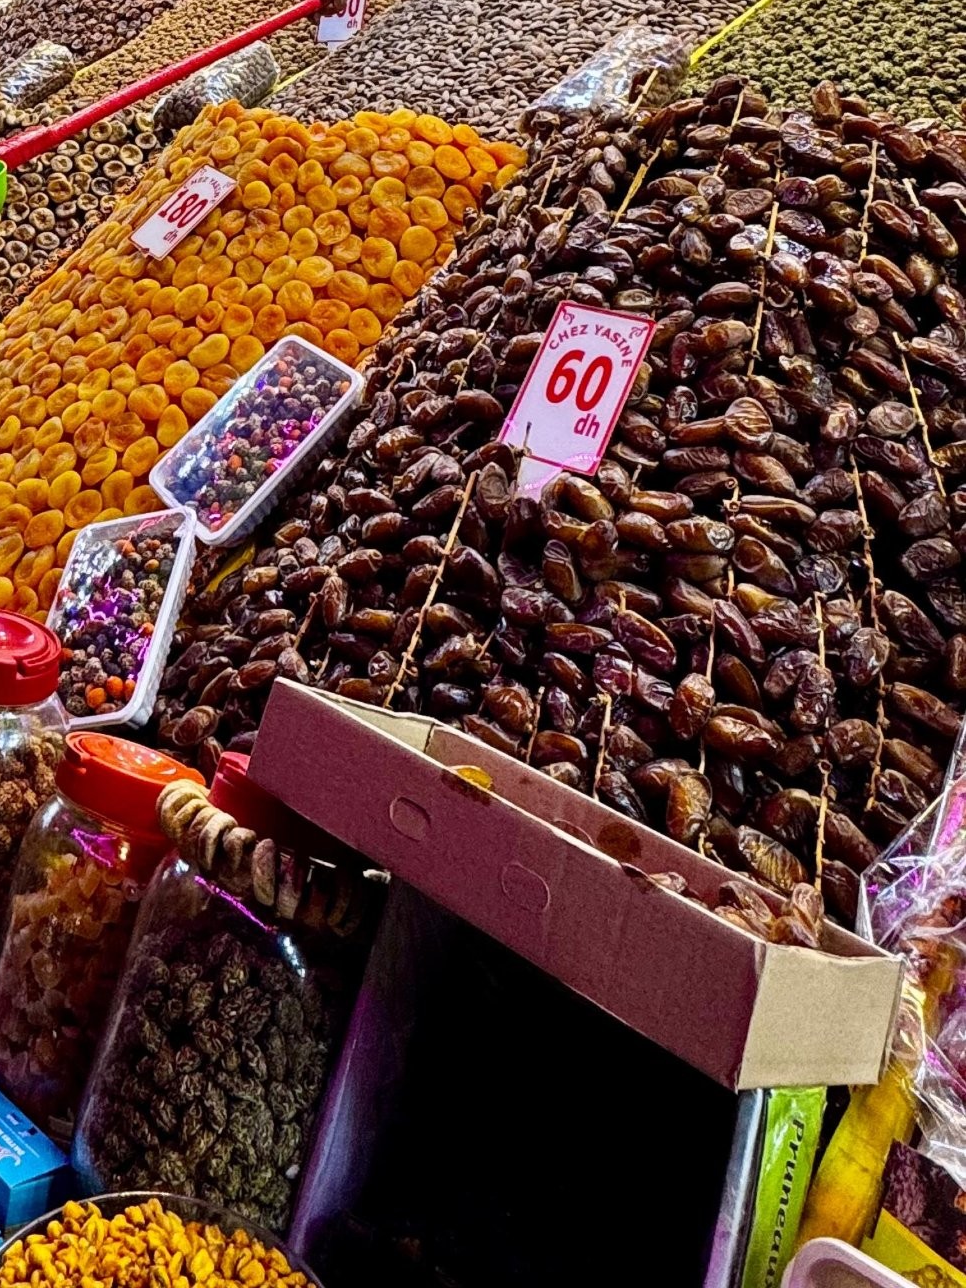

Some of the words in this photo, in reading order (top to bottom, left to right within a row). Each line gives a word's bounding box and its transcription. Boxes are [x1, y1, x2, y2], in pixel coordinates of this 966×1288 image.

[157, 189, 209, 229] 180
[548, 324, 589, 351] CHEZ
[594, 324, 634, 369] YASINE
[545, 349, 613, 412] 60
[573, 413, 601, 438] dh
